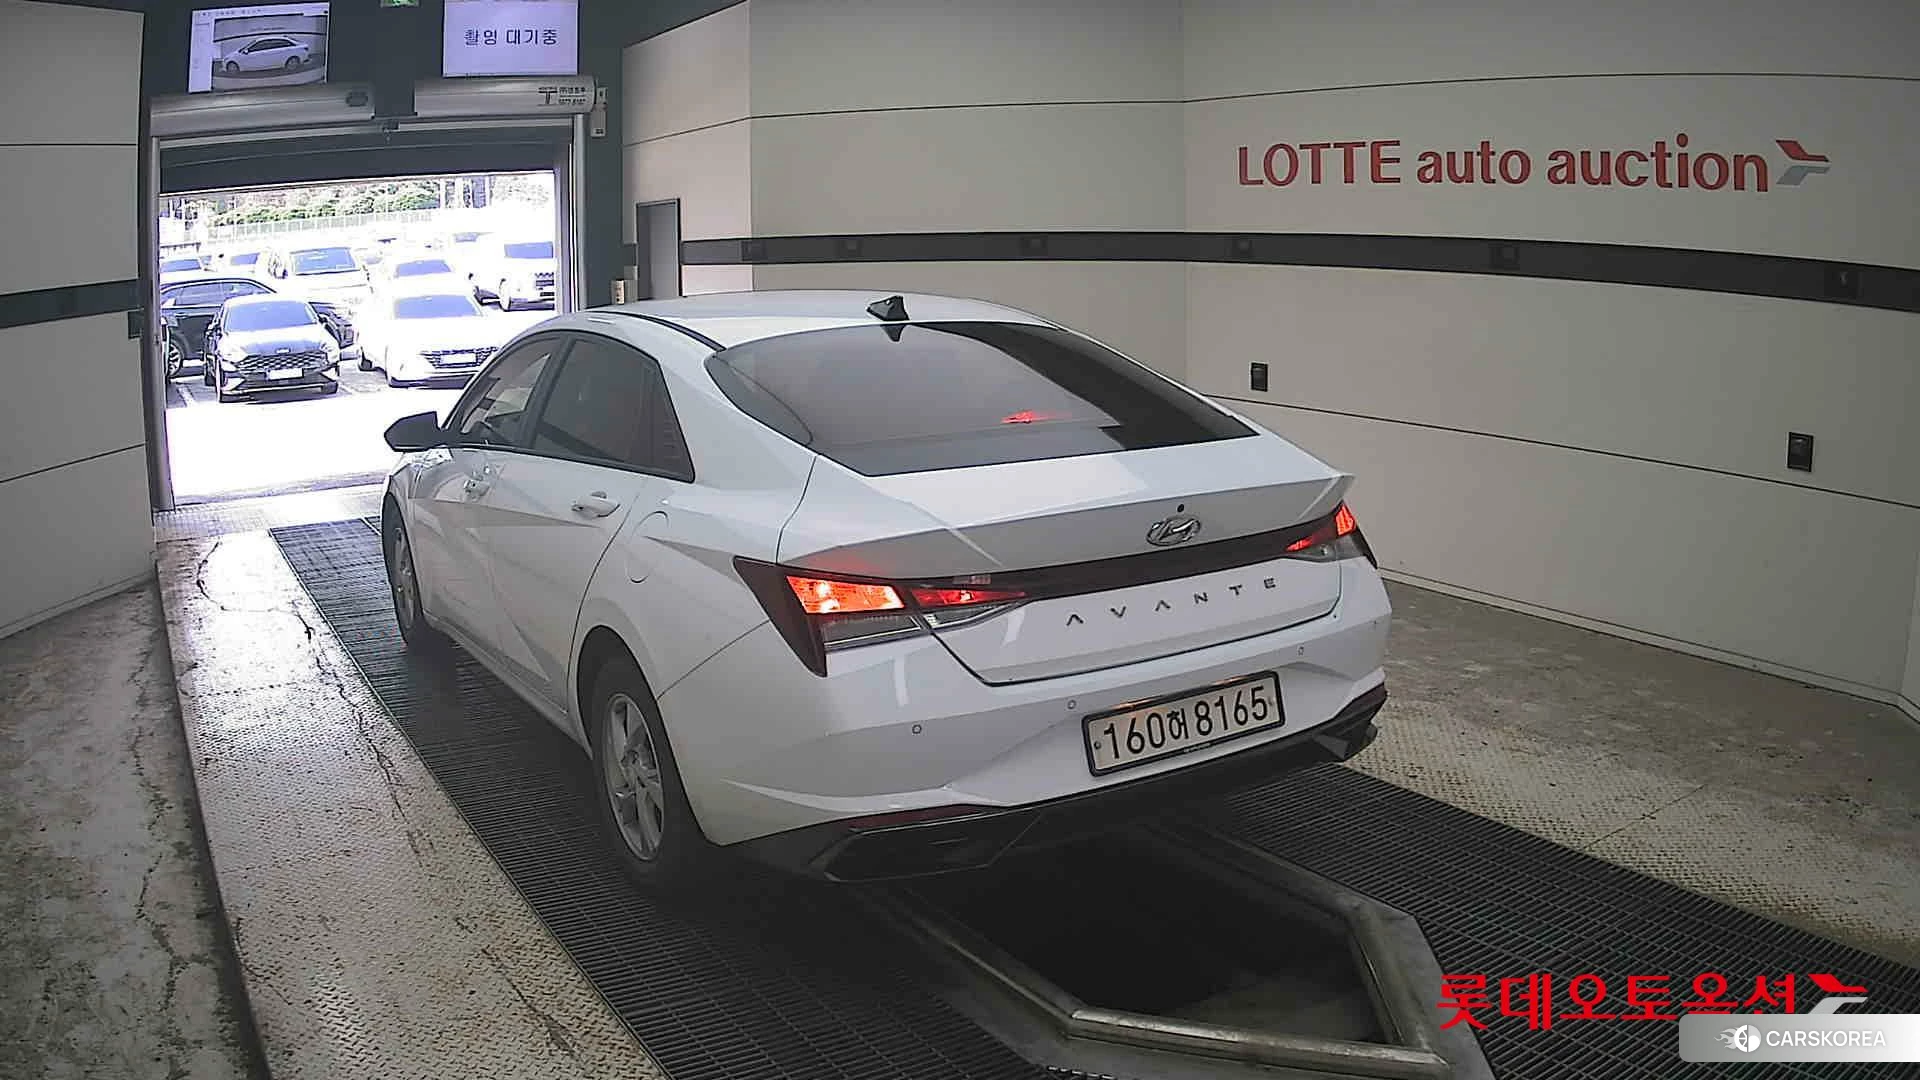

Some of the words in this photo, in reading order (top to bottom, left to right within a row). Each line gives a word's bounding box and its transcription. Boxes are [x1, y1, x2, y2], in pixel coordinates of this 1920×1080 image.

[505, 29, 557, 46] 대기중
[1238, 140, 1401, 186] LOTTE
[1416, 140, 1532, 185] auto
[1547, 134, 1769, 193] auction
[1066, 577, 1277, 627] AVANTE
